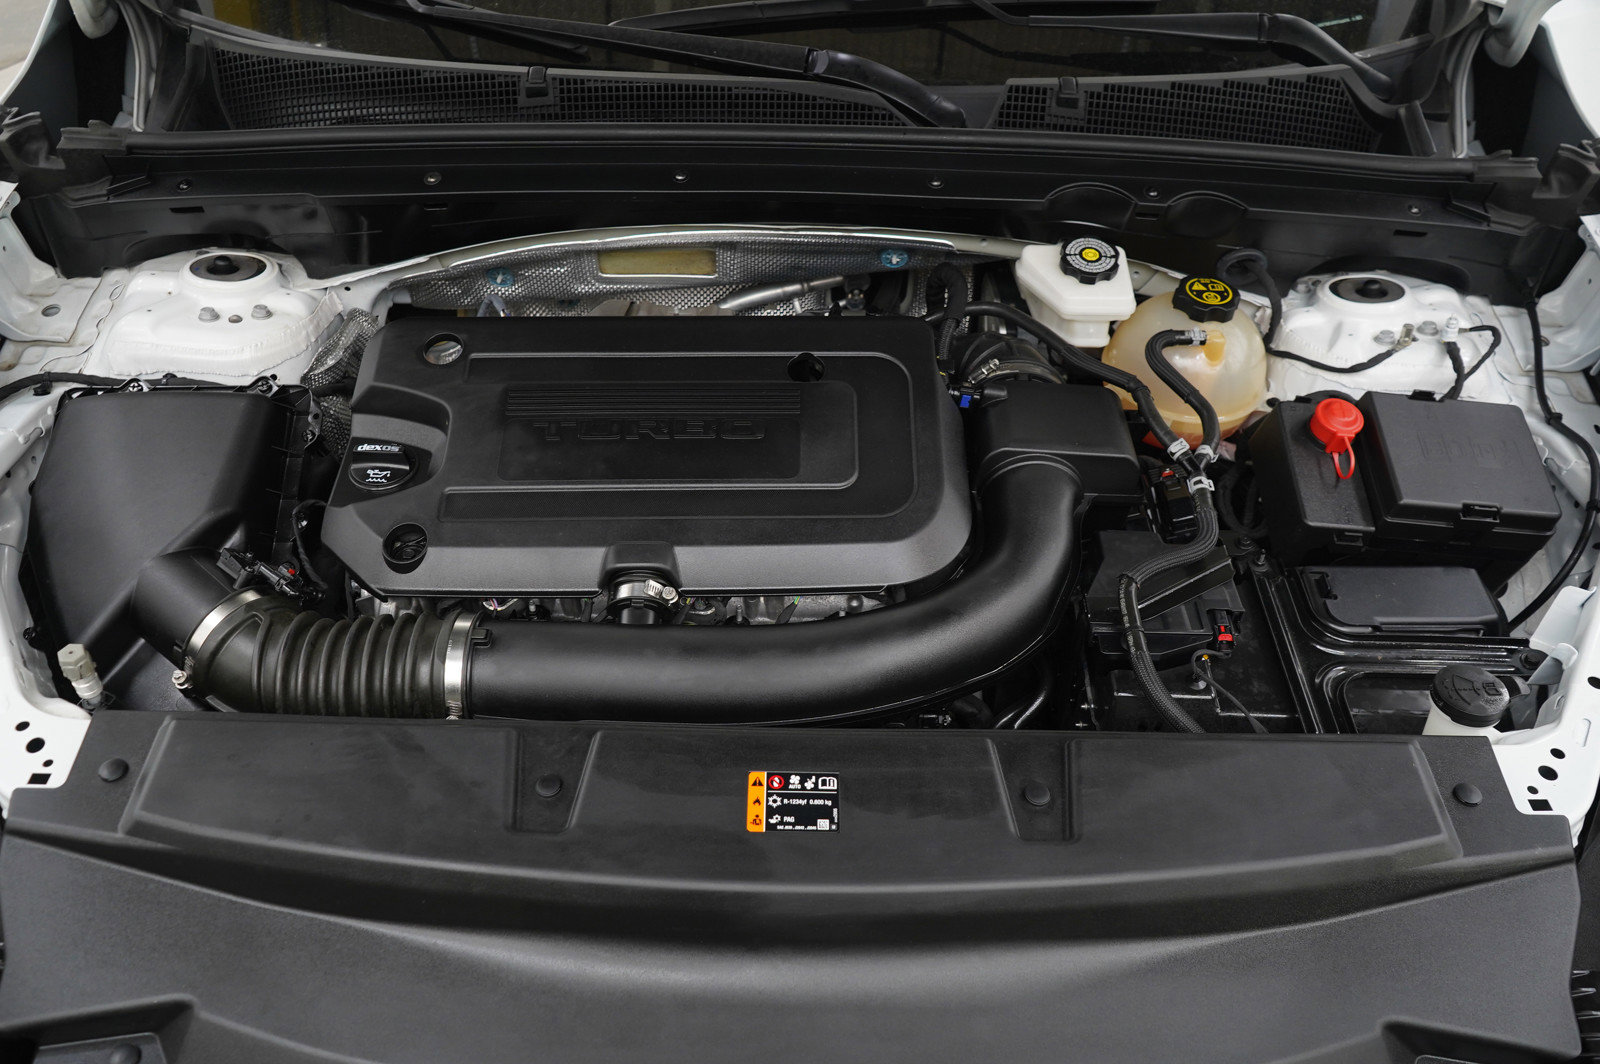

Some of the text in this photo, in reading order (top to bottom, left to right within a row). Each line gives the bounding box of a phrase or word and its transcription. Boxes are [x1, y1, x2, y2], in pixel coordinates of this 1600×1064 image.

[533, 421, 765, 440] TURBO
[357, 443, 400, 452] dexos
[783, 798, 807, 806] R-1234yf
[825, 799, 832, 807] kg
